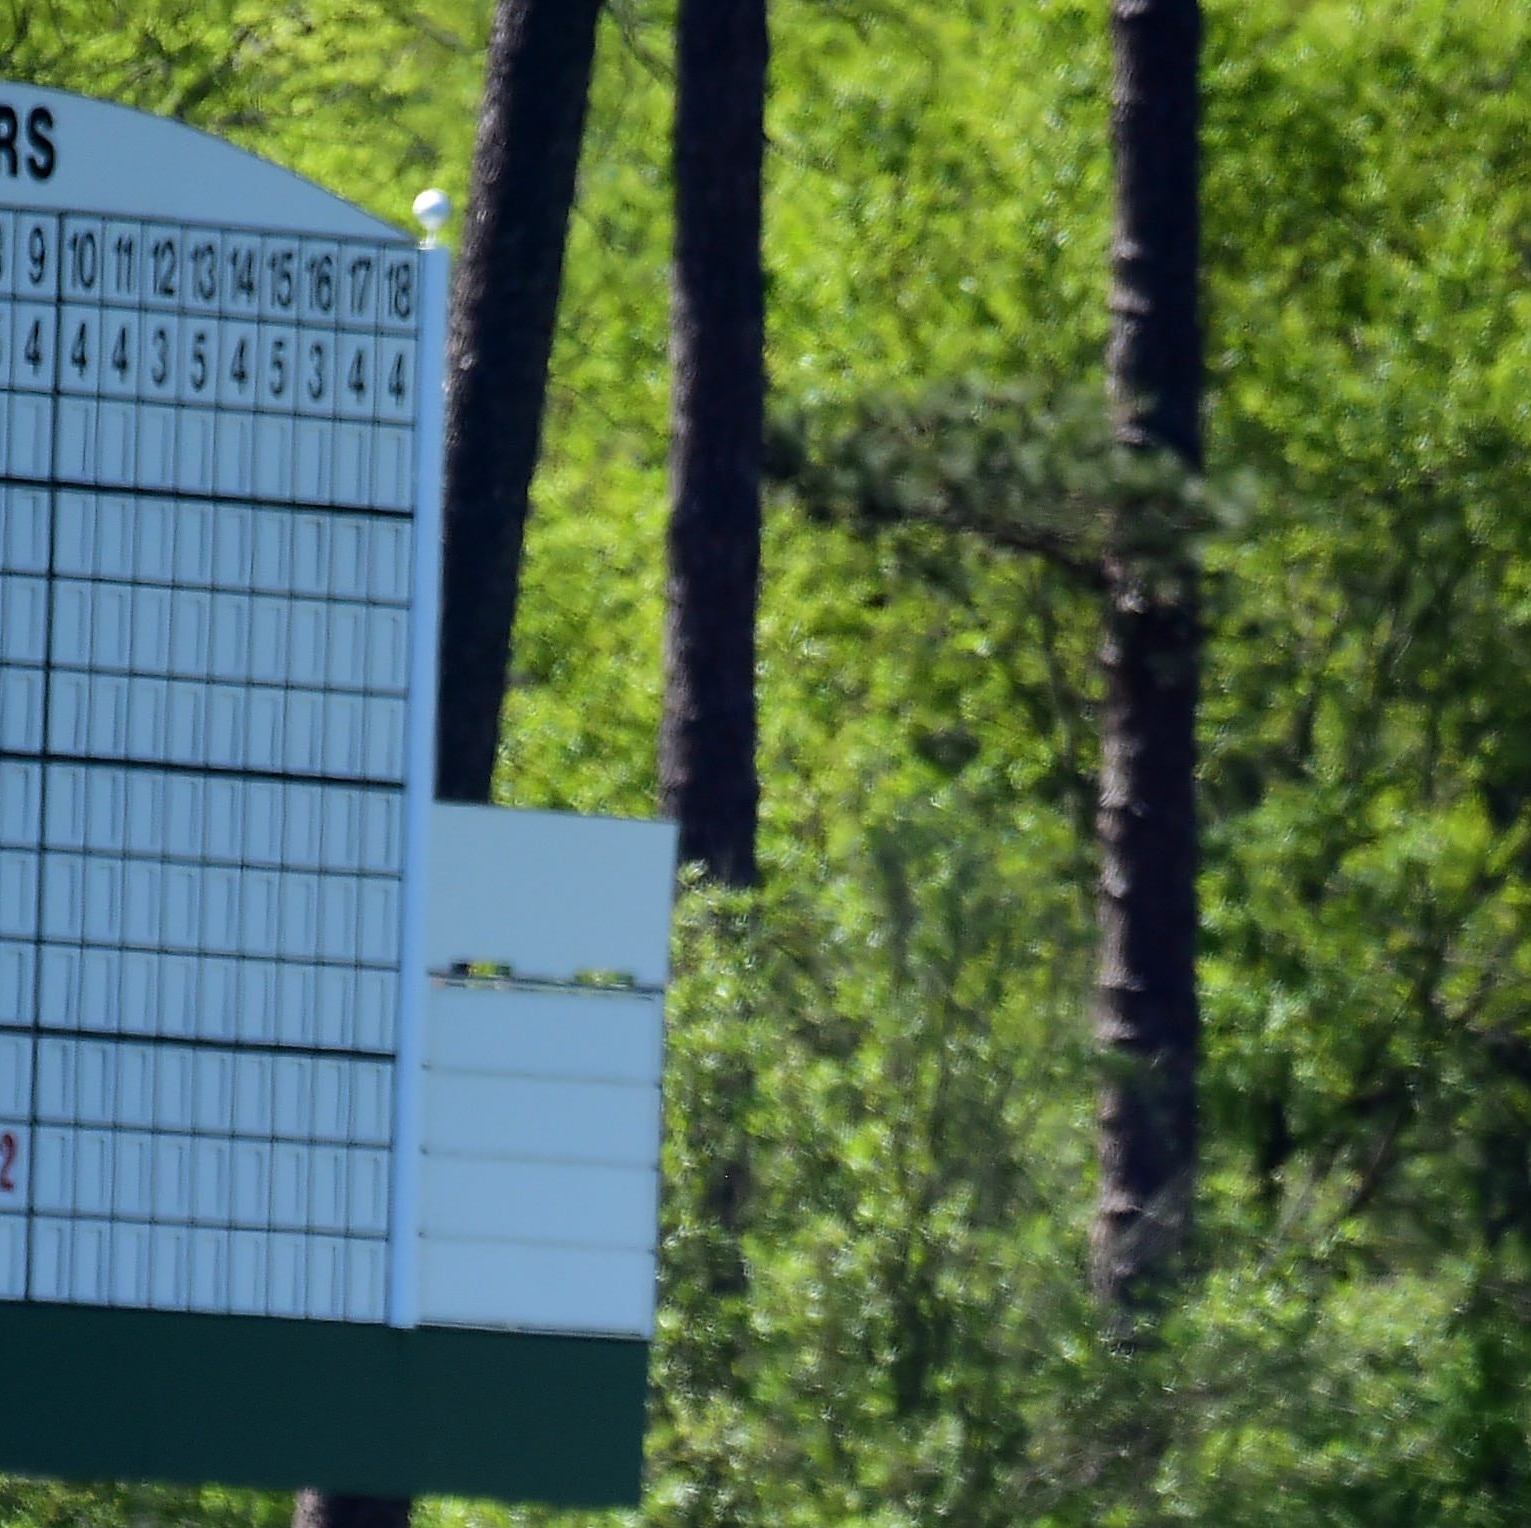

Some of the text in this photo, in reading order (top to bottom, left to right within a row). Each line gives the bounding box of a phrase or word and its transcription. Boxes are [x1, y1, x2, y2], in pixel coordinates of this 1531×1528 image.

[29, 228, 45, 284] 9
[70, 233, 95, 289] 10
[114, 236, 133, 293] 11
[151, 241, 176, 296] 12
[190, 244, 216, 301] 13
[230, 246, 254, 301] 14
[270, 250, 293, 308] 15
[305, 255, 333, 312] 16
[348, 257, 371, 316] 17
[386, 263, 412, 319] 18
[24, 319, 42, 375] 4
[72, 323, 88, 376] 4
[112, 327, 128, 381] 4
[153, 330, 167, 387] 3
[190, 333, 207, 391] 5
[230, 338, 248, 391] 4
[271, 341, 285, 398] 5
[308, 344, 324, 401] 3
[348, 348, 365, 402] 4
[388, 353, 406, 407] 4
